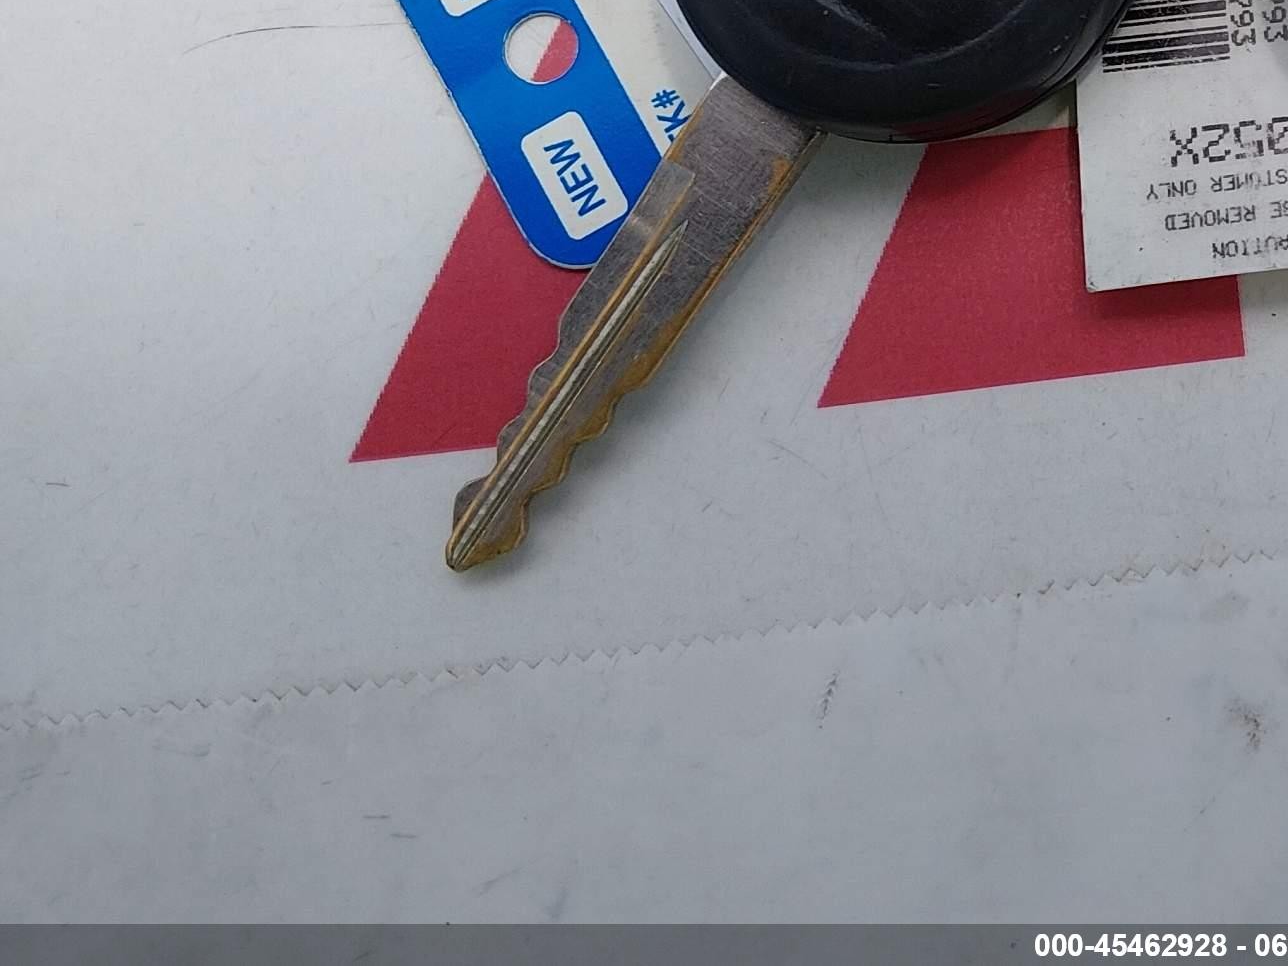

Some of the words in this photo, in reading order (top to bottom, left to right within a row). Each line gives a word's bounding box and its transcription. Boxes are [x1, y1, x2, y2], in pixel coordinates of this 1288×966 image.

[543, 139, 606, 217] NEW
[1145, 178, 1198, 201] ONLY
[1164, 205, 1257, 232] REMOVED
